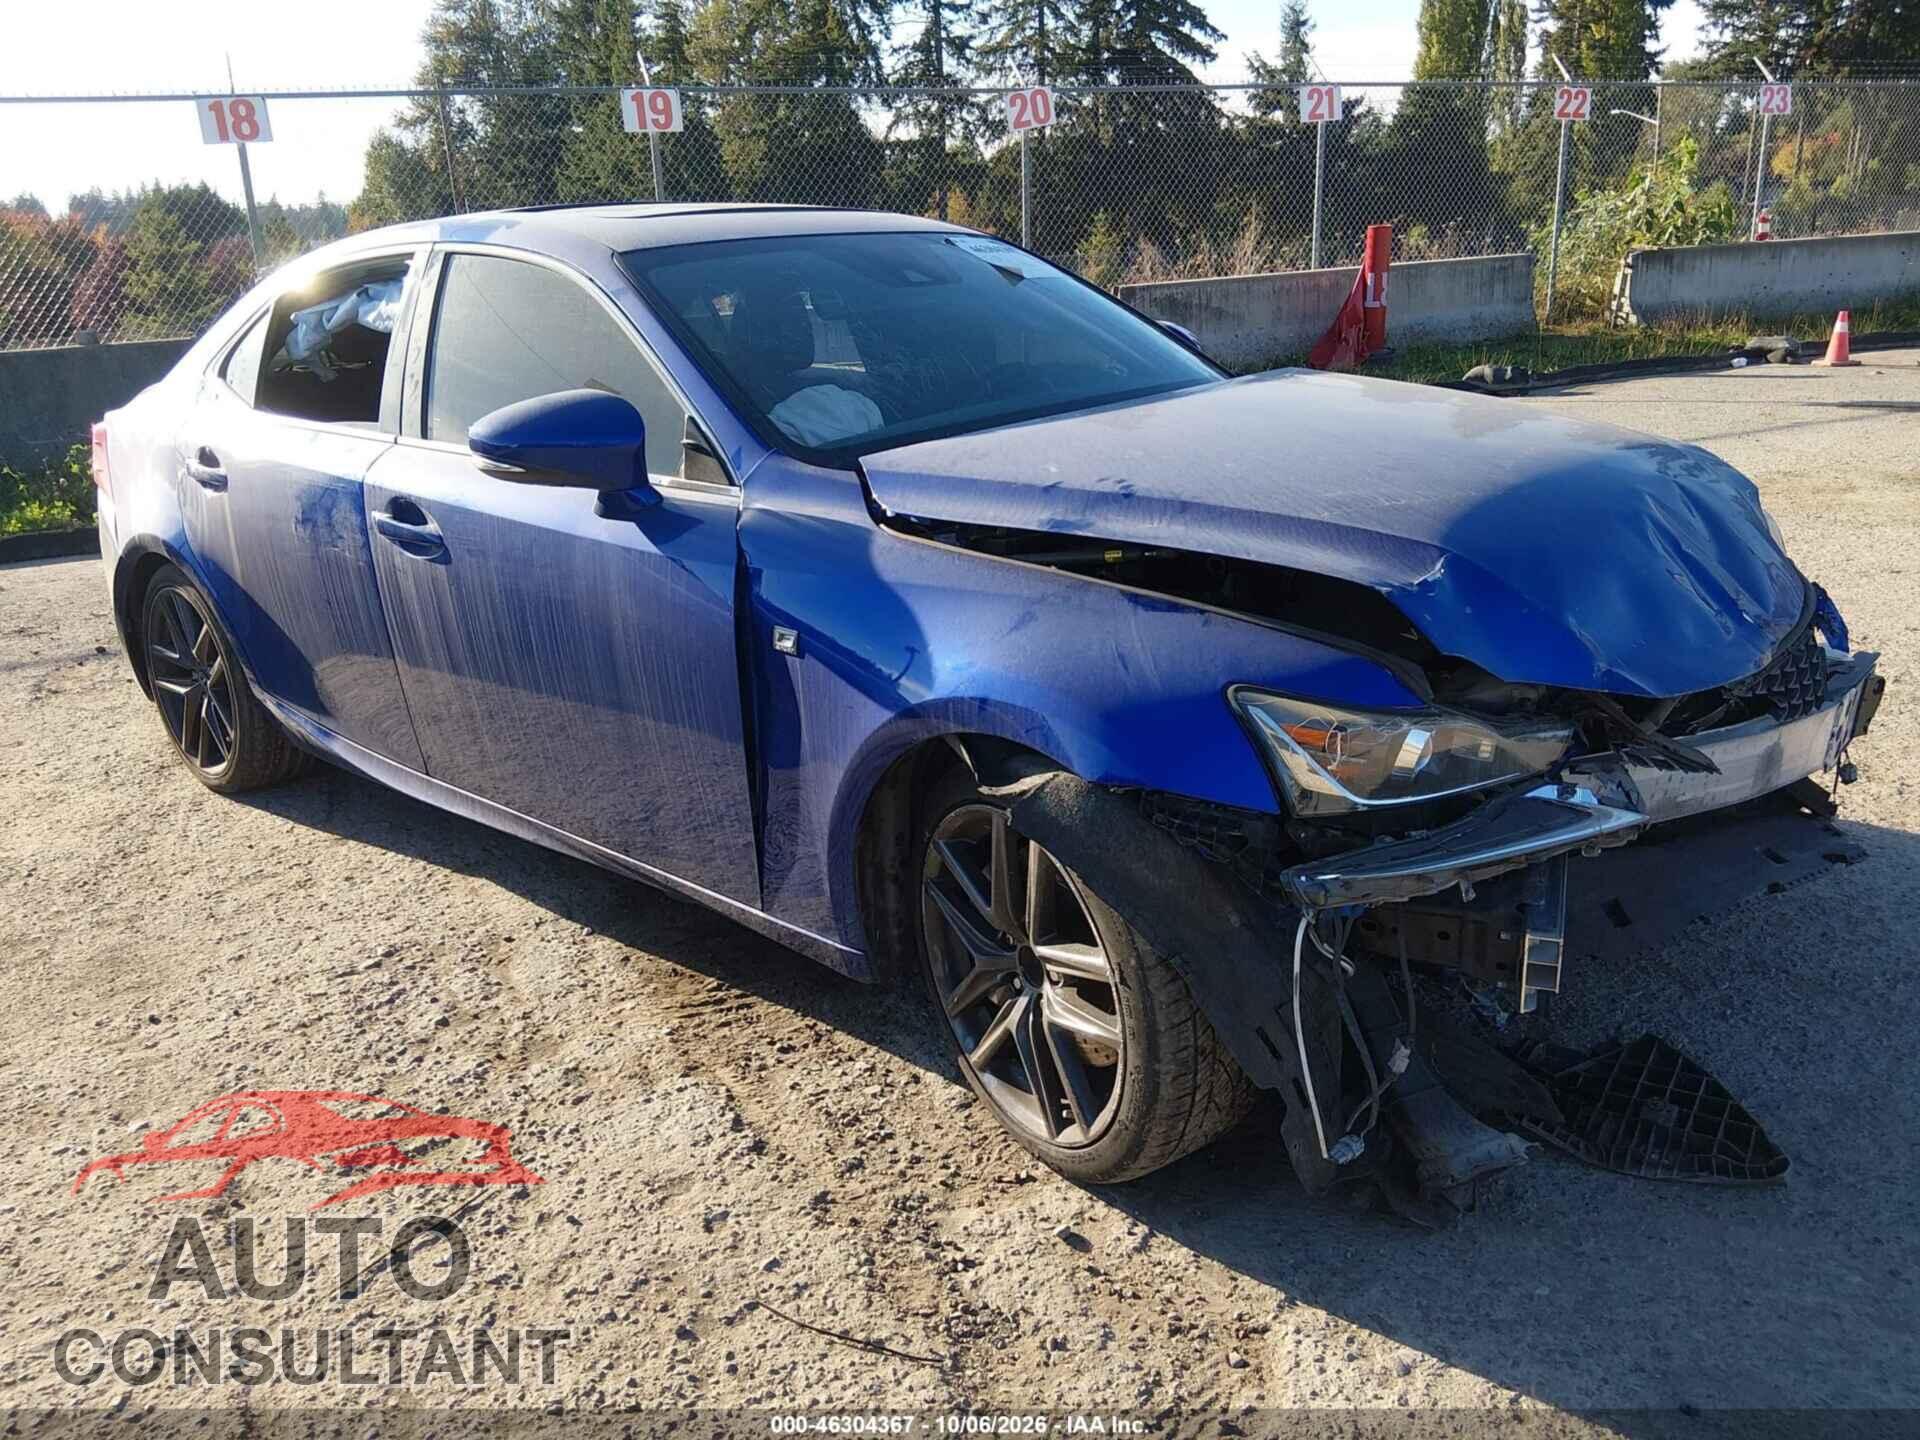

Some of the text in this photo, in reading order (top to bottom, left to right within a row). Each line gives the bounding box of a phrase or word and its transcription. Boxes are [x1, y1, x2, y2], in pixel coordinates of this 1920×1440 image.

[631, 90, 674, 130] 19
[1009, 88, 1051, 129] 20
[1307, 87, 1335, 120] 21
[1557, 87, 1588, 118] 22
[1763, 86, 1788, 113] 23
[209, 99, 260, 142] 18
